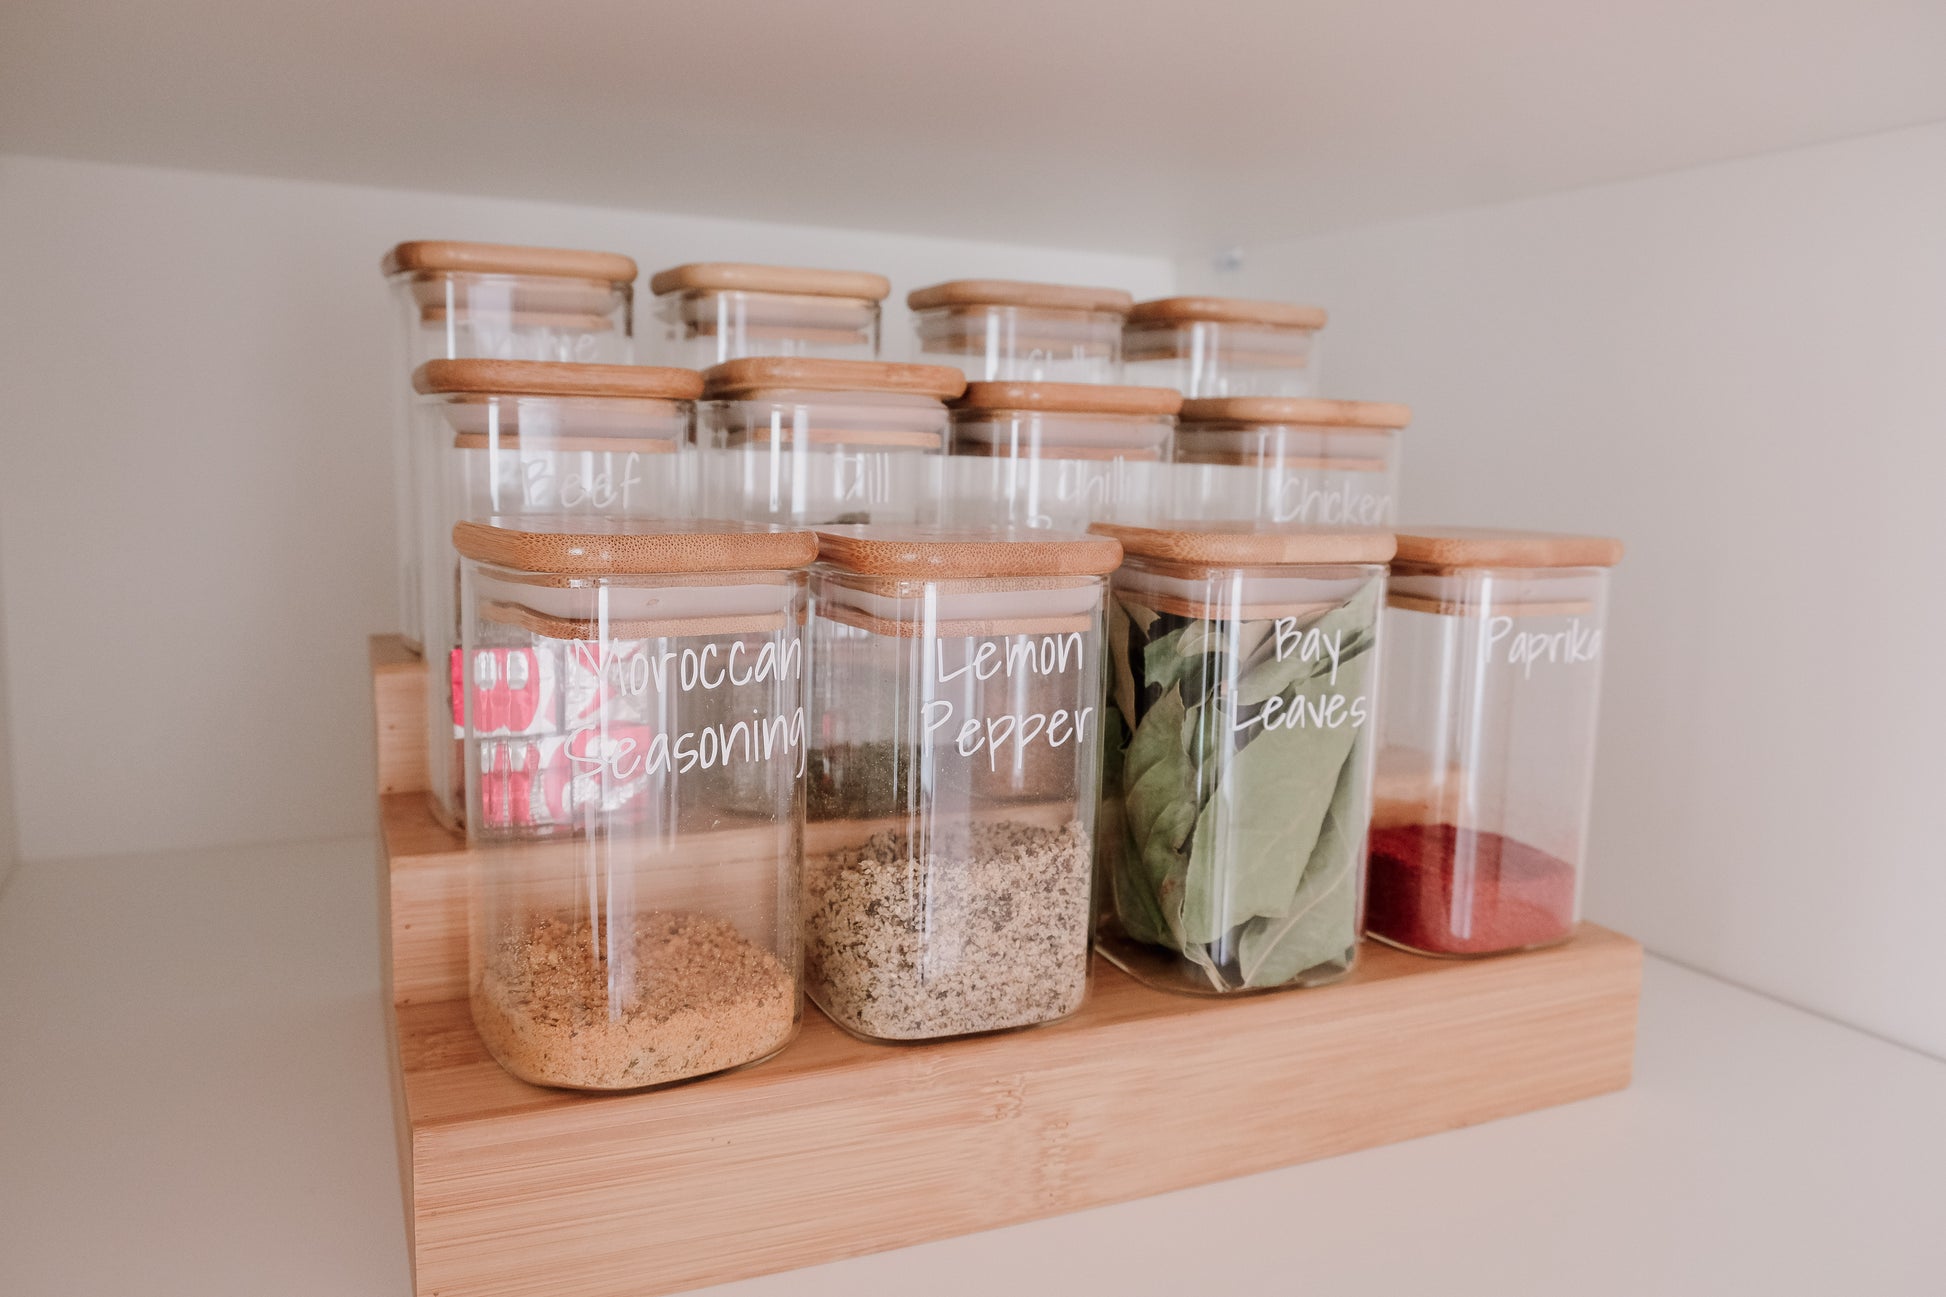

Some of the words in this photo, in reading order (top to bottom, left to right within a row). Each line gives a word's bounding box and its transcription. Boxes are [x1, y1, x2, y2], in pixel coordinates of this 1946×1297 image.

[522, 450, 642, 511] Beef
[573, 637, 802, 697] Moroccan
[936, 631, 1084, 684] Lemon
[1273, 615, 1342, 686] Bay
[920, 699, 1094, 773] Pepper
[1230, 690, 1368, 733] Leaves
[563, 706, 807, 780] Seasoning
